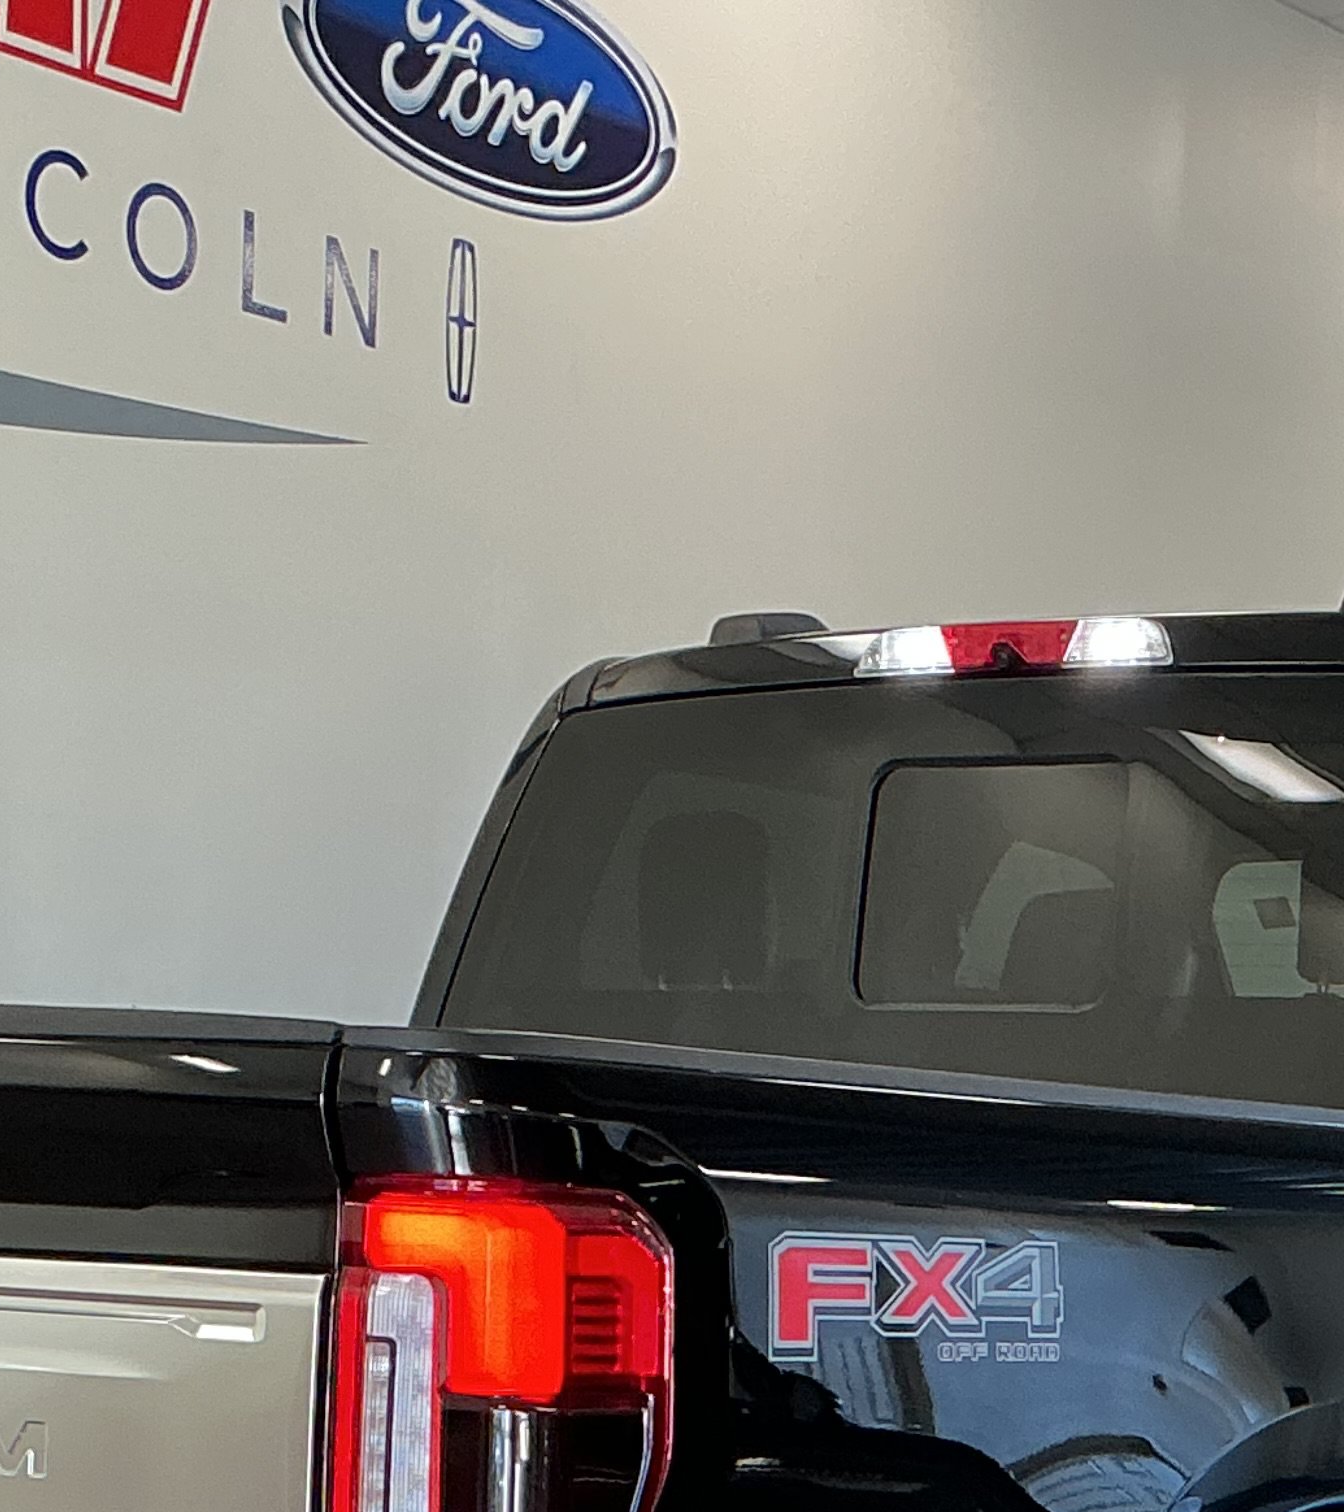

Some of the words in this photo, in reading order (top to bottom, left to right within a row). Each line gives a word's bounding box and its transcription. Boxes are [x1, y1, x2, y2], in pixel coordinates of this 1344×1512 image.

[381, 0, 594, 171] Ford
[767, 1231, 1064, 1362] FX4
[937, 1342, 989, 1362] OFF
[995, 1342, 1060, 1362] ROAD
